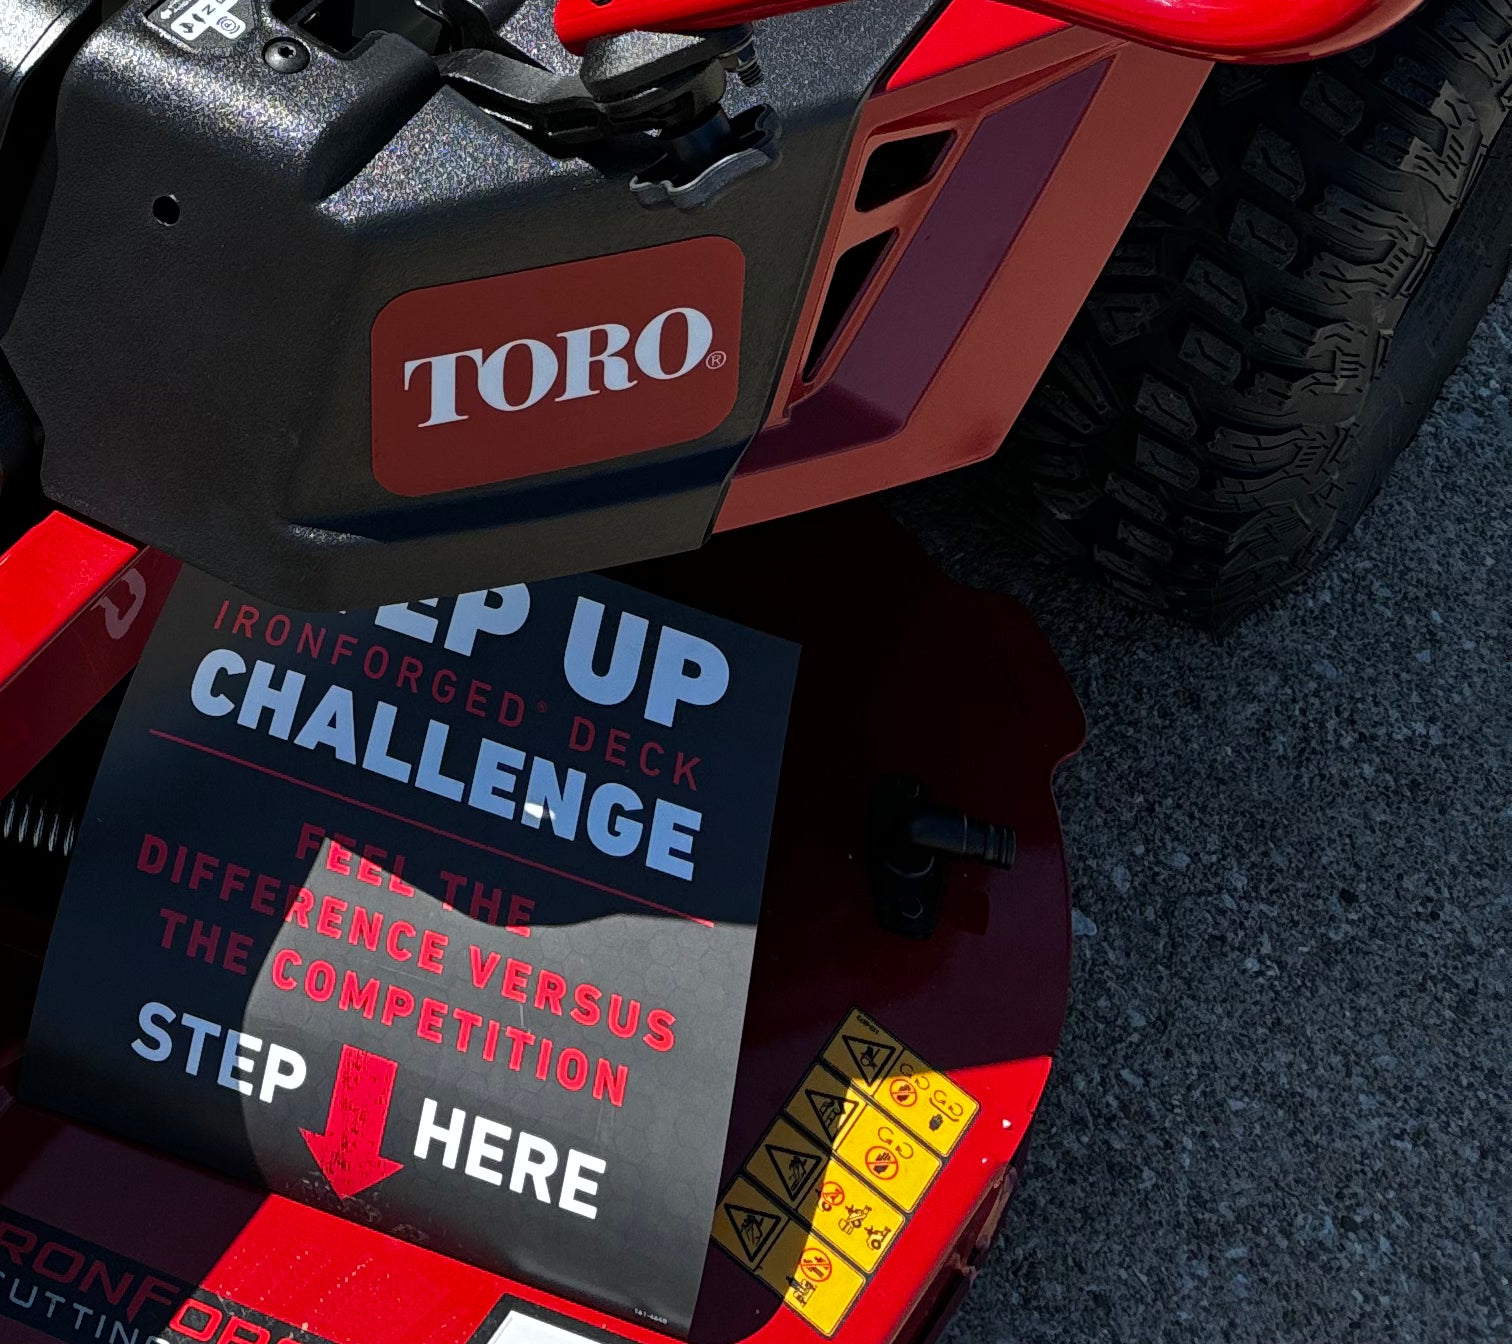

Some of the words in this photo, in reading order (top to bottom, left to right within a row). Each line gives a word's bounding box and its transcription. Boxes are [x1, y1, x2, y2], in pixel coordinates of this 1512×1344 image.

[563, 595, 730, 728] UP
[569, 715, 702, 791] DECK
[190, 648, 703, 882] CHALLENGE
[136, 833, 449, 975] DIFFERENCE
[469, 944, 677, 1052] VERSUS
[295, 822, 416, 898] FEEL
[439, 869, 537, 938] THE
[158, 907, 255, 975] THE
[271, 948, 629, 1108] COMPETITION
[130, 1001, 307, 1104] STEP
[413, 1097, 607, 1220] HERE
